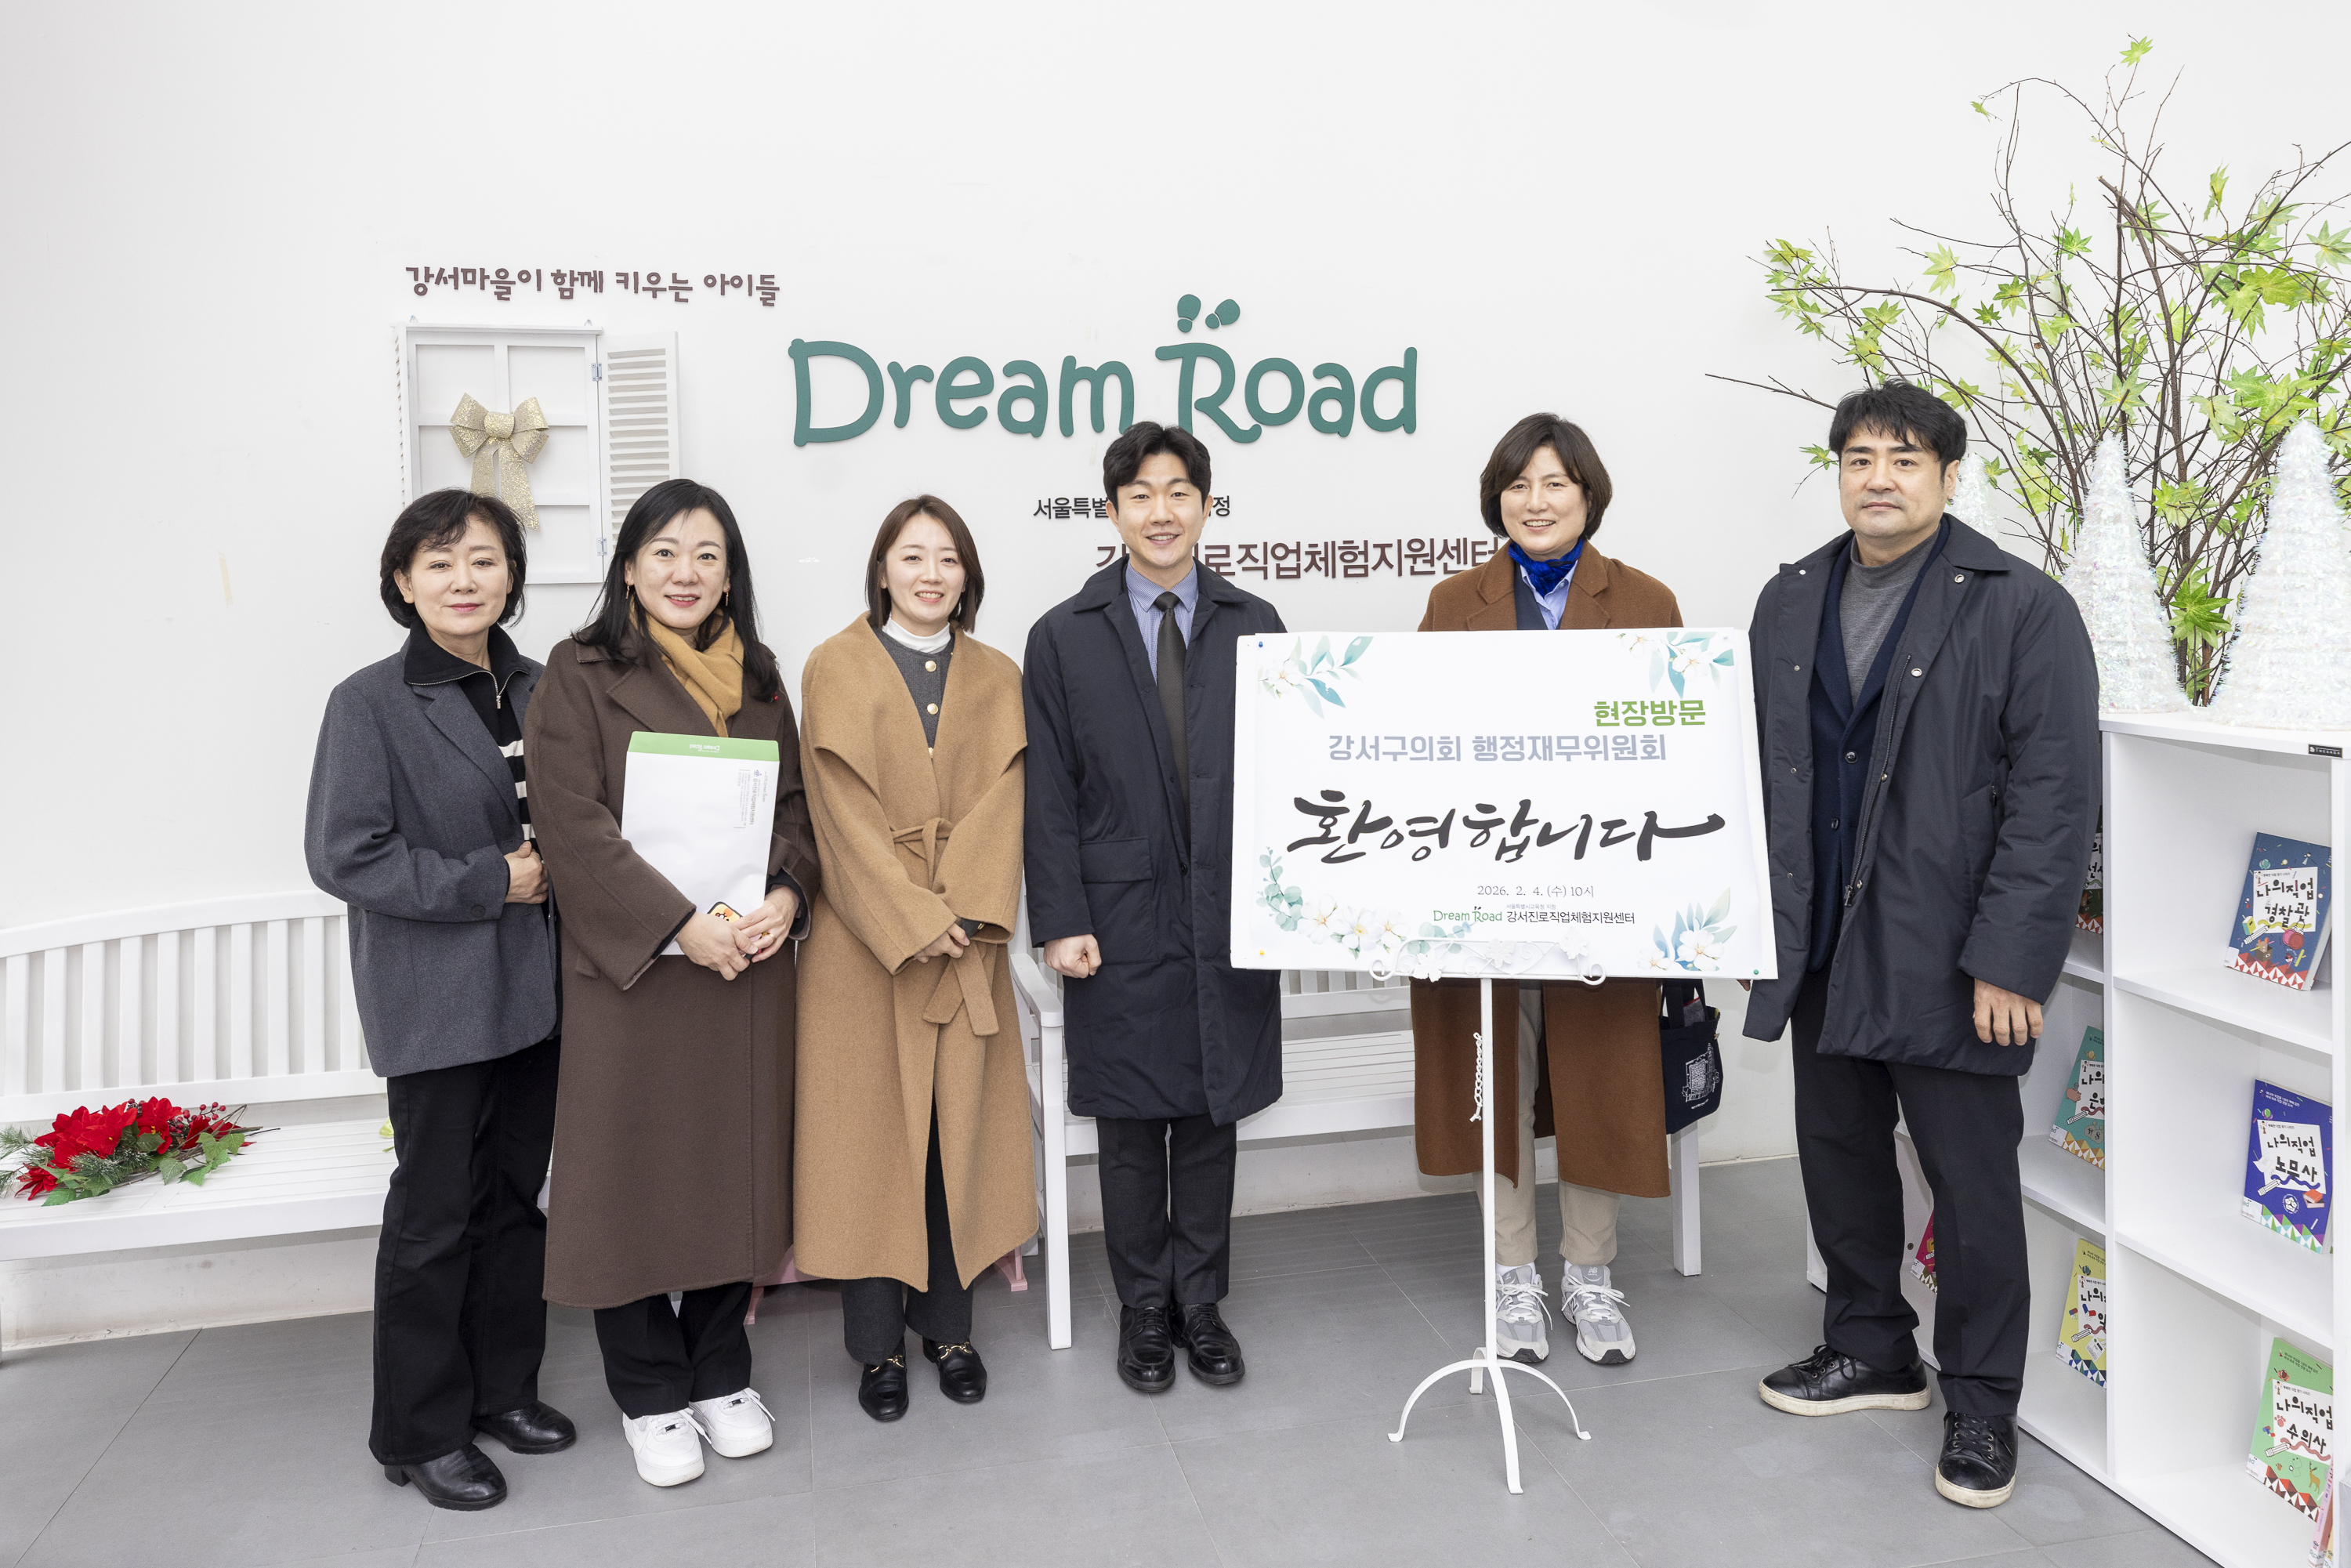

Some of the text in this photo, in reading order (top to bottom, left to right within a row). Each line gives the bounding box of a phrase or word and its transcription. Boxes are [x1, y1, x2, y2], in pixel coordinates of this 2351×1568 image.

[406, 266, 780, 307] 강서마을이 함께 키우는 아이들
[788, 339, 1417, 447] Dream Road
[1033, 495, 1230, 520] 서울특별 정
[1593, 700, 1707, 727] 현장방문
[1329, 733, 1666, 762] 강서구의회 행정재무위원회
[1287, 788, 1726, 864] 환영합니다
[1477, 885, 1594, 898] 2026. 2. 4. (수) 10시
[1433, 911, 1635, 924] Dream Road 강서진로직업체험지원센터
[2265, 903, 2309, 928] 경찰관
[2081, 1070, 2104, 1085] 나의
[2276, 1156, 2317, 1182] 노무사
[2081, 1287, 2106, 1302] 나의
[2286, 1424, 2326, 1454] 수의사
